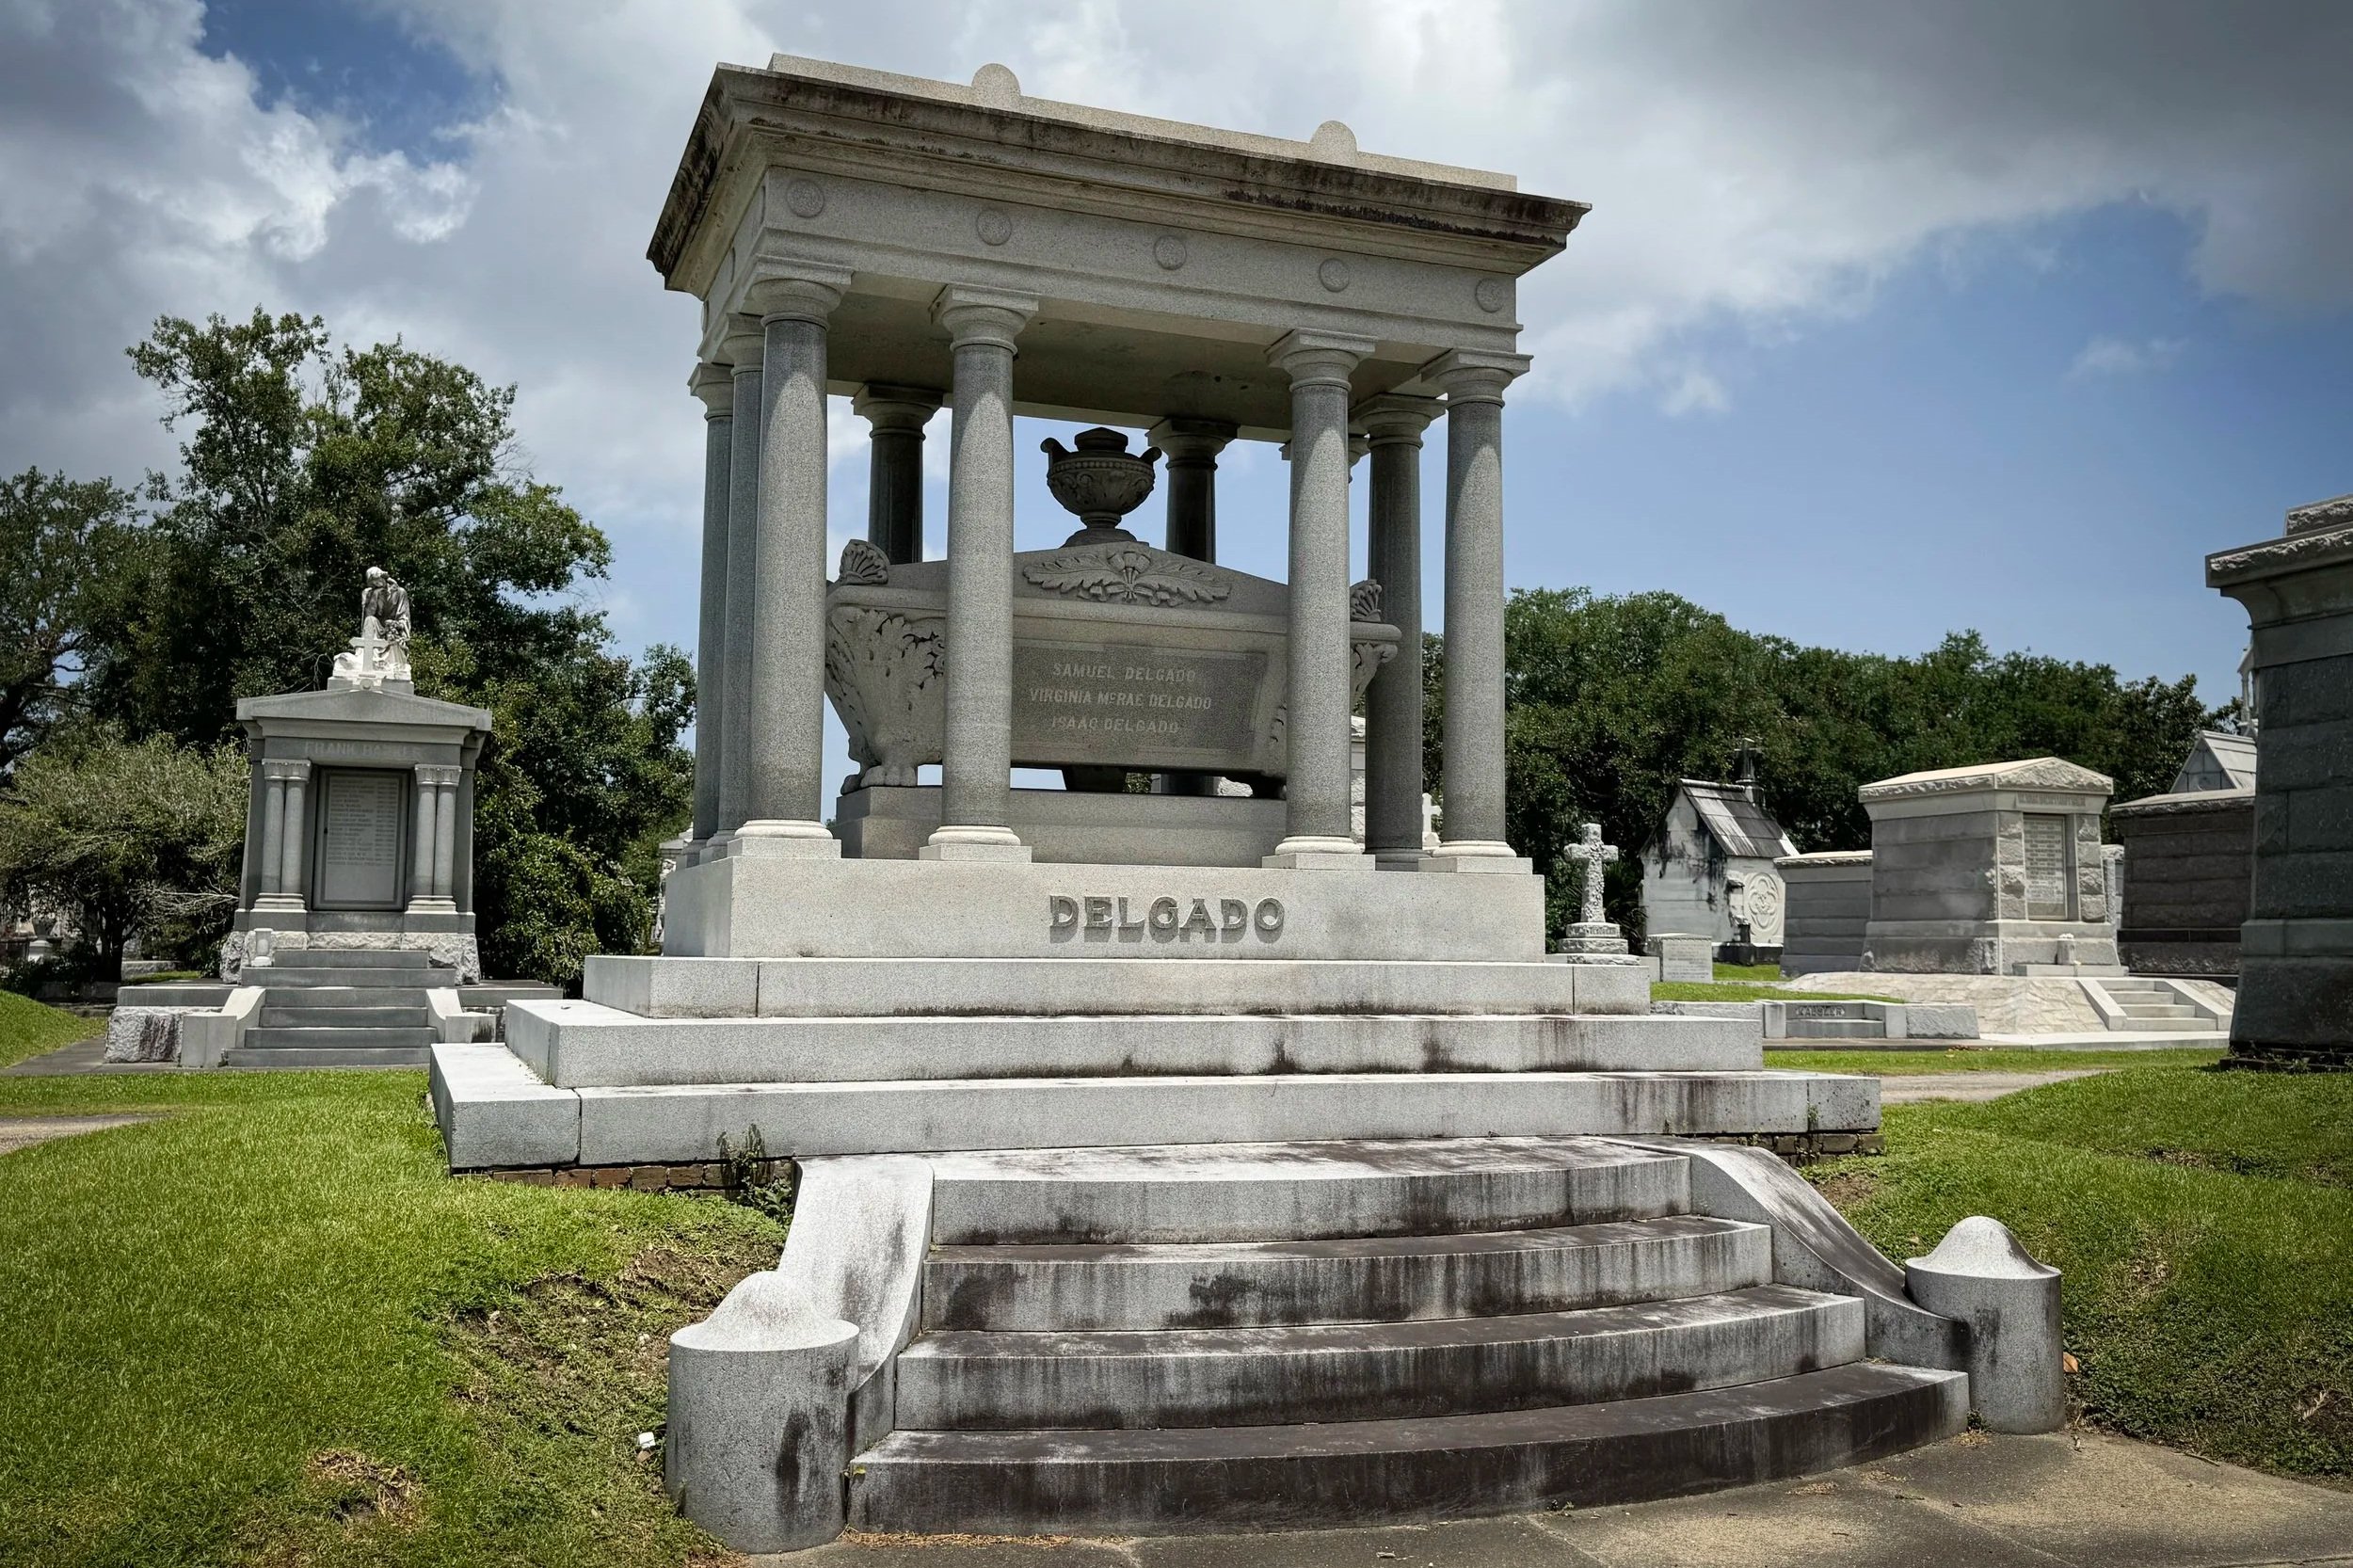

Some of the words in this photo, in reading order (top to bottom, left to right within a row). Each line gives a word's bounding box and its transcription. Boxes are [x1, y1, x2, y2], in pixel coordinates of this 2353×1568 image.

[1052, 663, 1115, 679] SAMUEL
[1124, 666, 1196, 682] DELGADO
[1030, 687, 1092, 704] VIRGINIA
[1148, 694, 1211, 710] DELGADO
[1051, 715, 1099, 731] ISAAC
[1104, 718, 1178, 734] DELGADO
[1049, 895, 1286, 931] DELGADO
